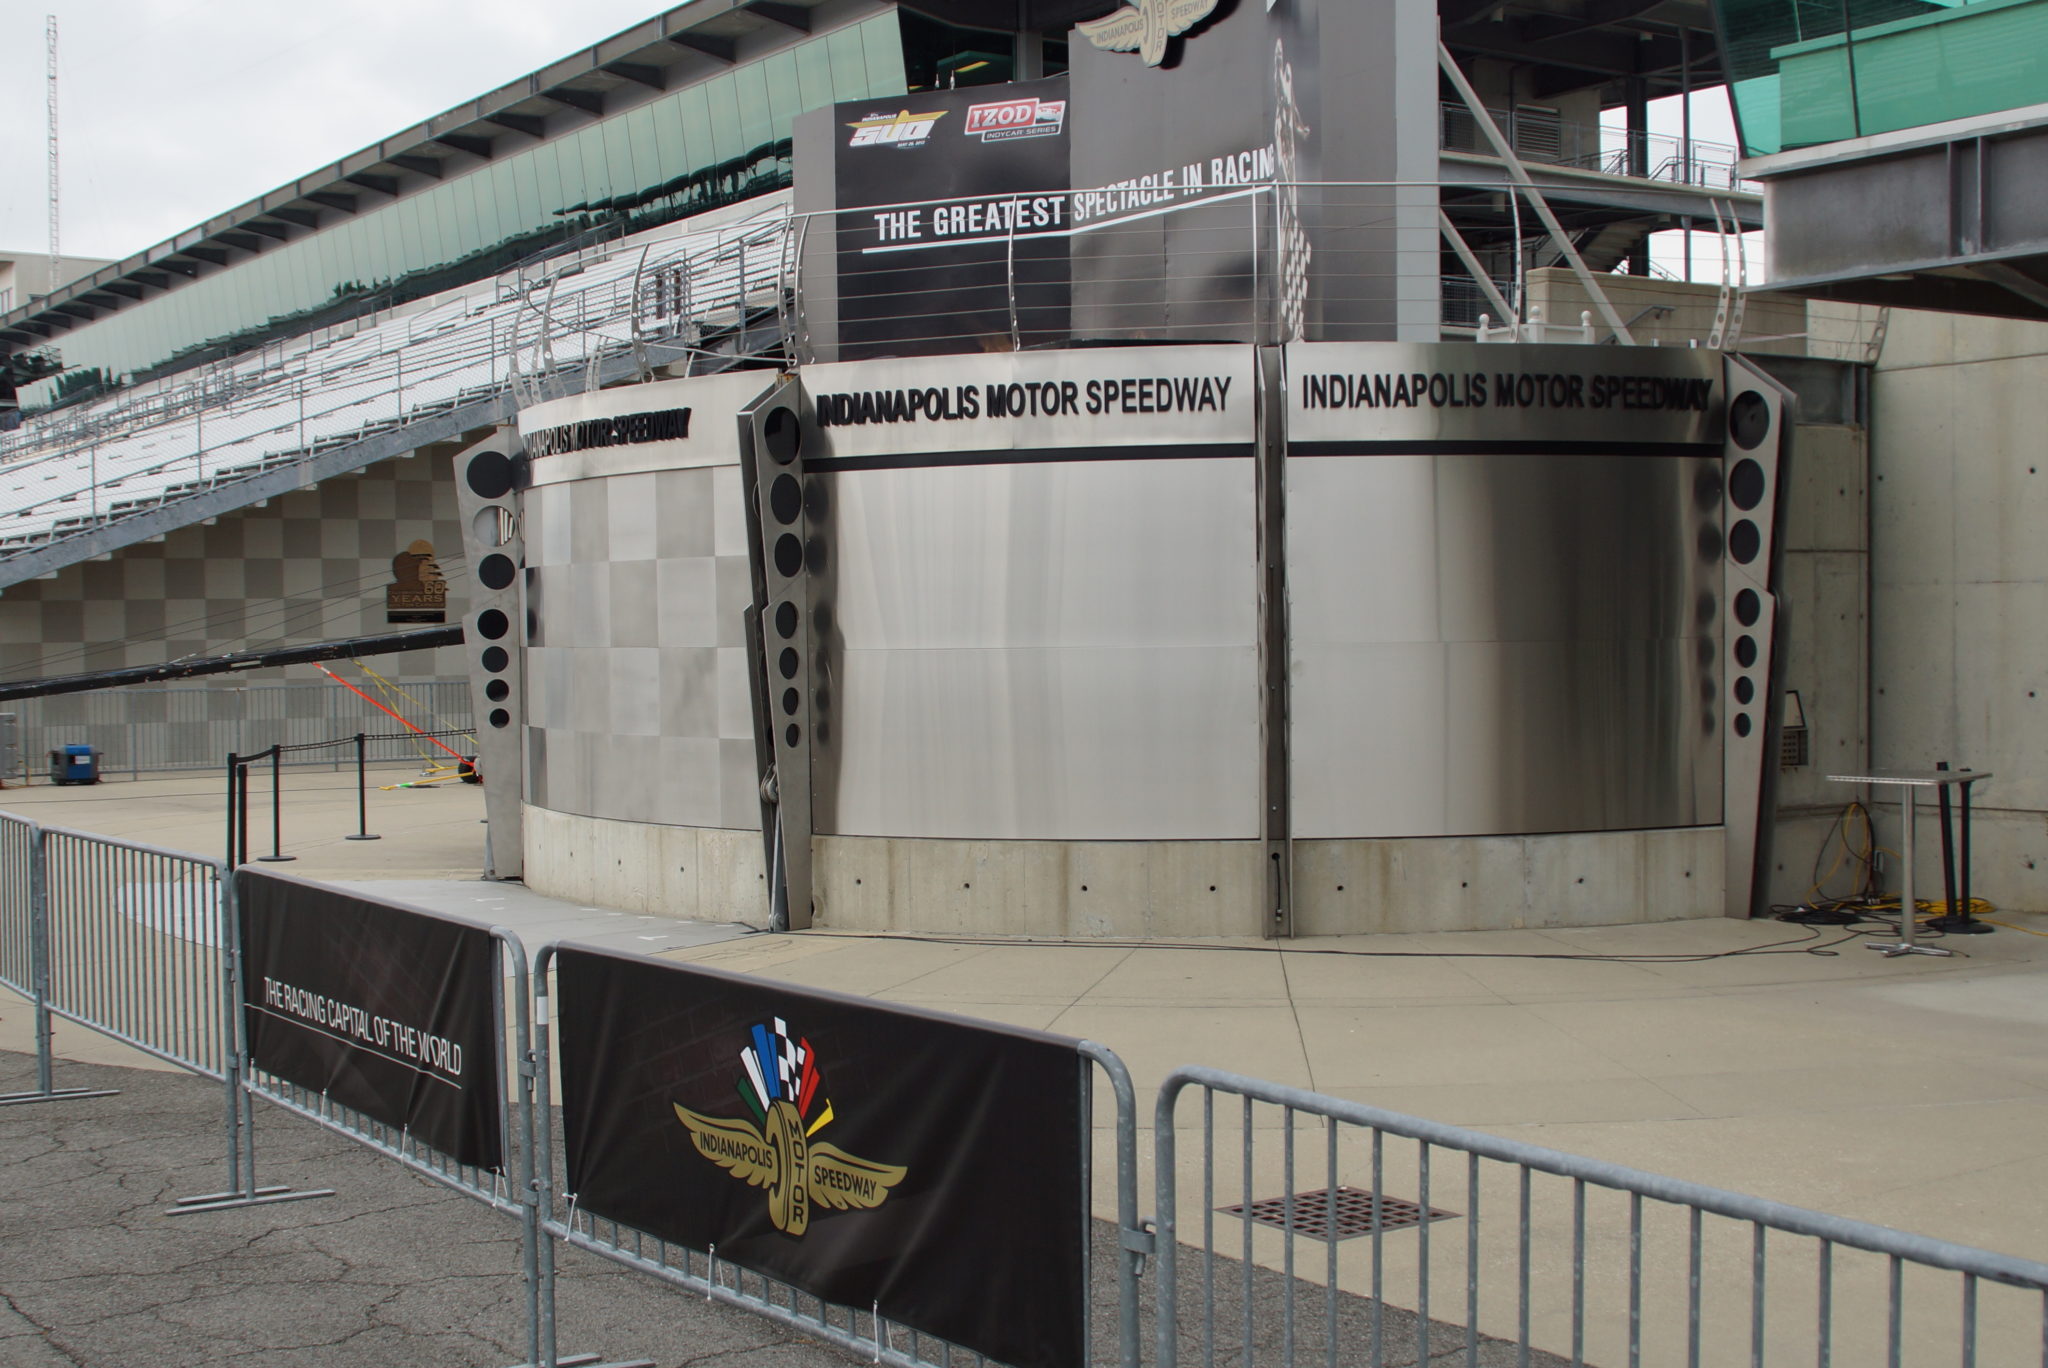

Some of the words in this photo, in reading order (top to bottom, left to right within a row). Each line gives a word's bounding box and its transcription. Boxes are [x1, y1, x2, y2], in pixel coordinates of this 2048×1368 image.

[1096, 19, 1144, 45] INDIANAPOLIS
[1155, 0, 1165, 52] OTOR
[971, 105, 1032, 129] IZOD
[986, 129, 1022, 139] INDYCAR
[1025, 126, 1057, 135] SERIES
[874, 210, 922, 241] THE
[933, 196, 1066, 236] GREATEST
[1073, 169, 1175, 221] SPECTACLE
[1182, 163, 1203, 196] IN
[1211, 144, 1275, 185] RACING
[817, 385, 979, 427] INDIANAPOLIS
[986, 380, 1079, 419] MOTOR
[1085, 376, 1232, 414] SPEEDWAY
[1302, 373, 1487, 409] INDIANAPOLIS
[1495, 374, 1585, 409] MOTOR
[1588, 375, 1713, 411] SPEEDWAY
[569, 418, 613, 453] MOTOR
[612, 407, 692, 444] SPEEDWAY
[391, 594, 443, 603] YEARS
[424, 581, 446, 594] 60
[264, 976, 283, 1009] THE
[284, 983, 326, 1024] RACING
[327, 999, 374, 1042] CAPITAL
[374, 1016, 391, 1047] OF
[391, 1021, 418, 1058] THE
[417, 1030, 462, 1075] WORLD
[699, 1131, 773, 1169] INDIANAPOLIS
[787, 1119, 805, 1225] MOTOR
[814, 1166, 878, 1201] SPEEDWAY
